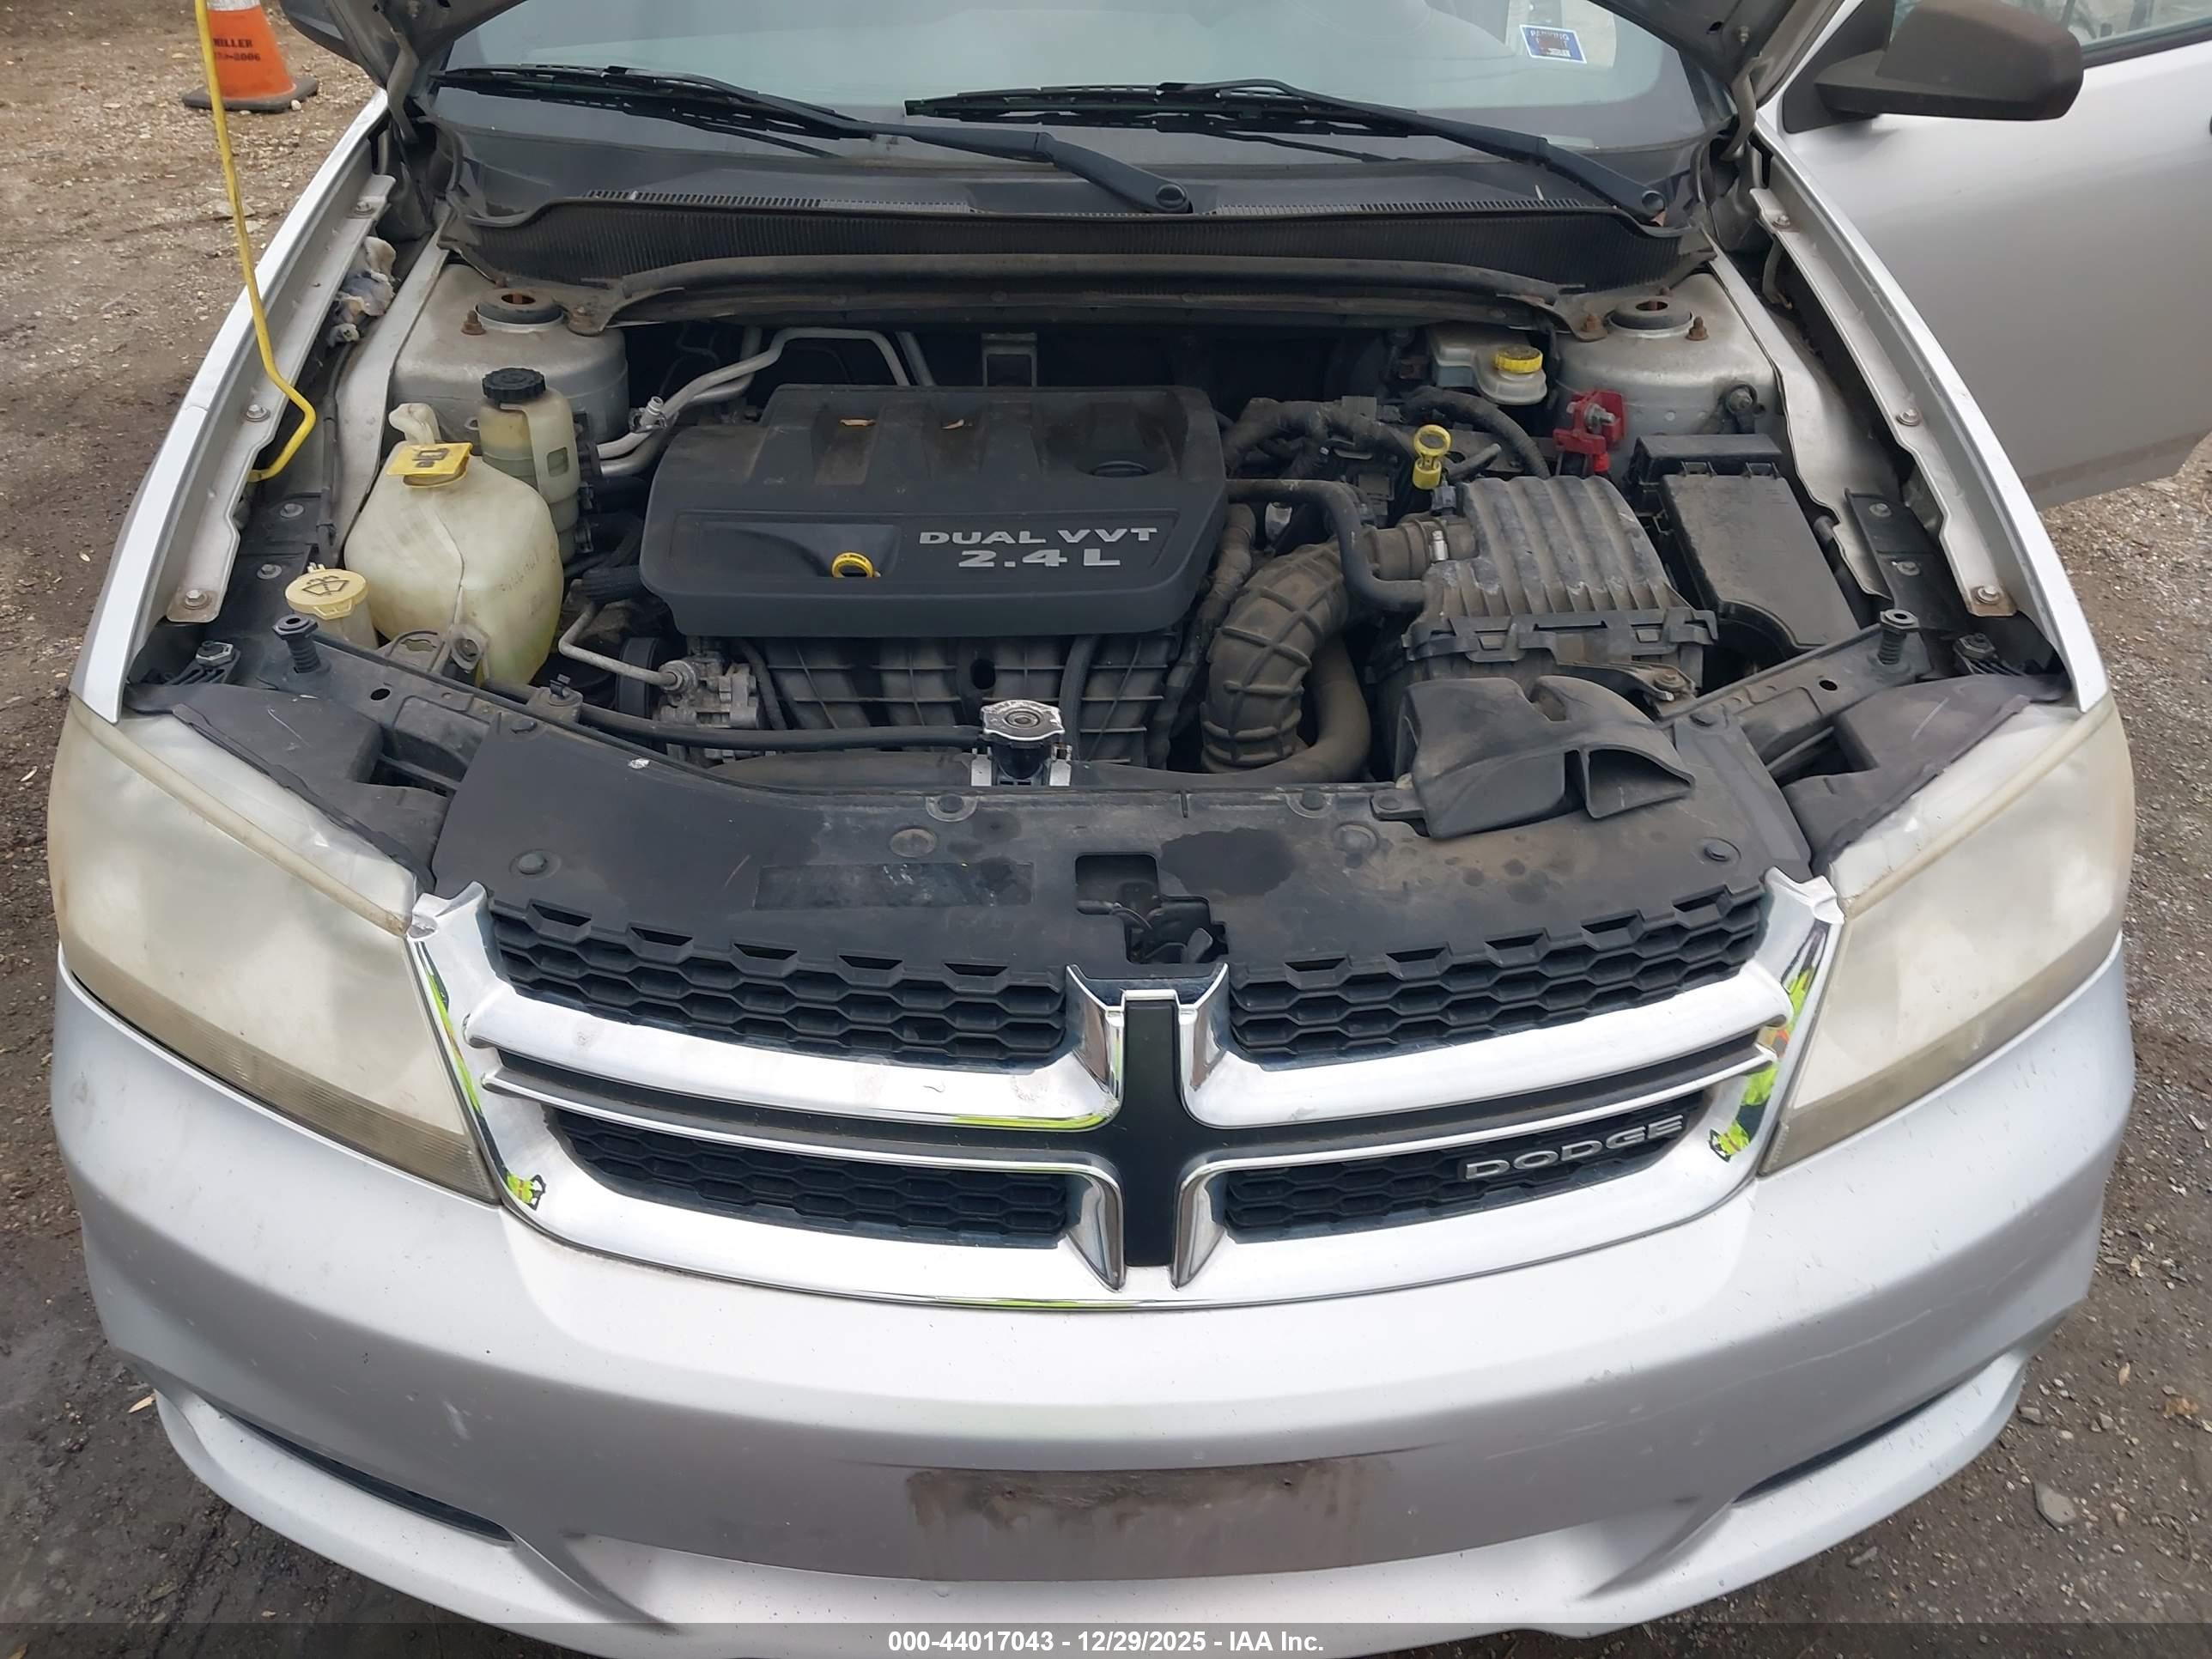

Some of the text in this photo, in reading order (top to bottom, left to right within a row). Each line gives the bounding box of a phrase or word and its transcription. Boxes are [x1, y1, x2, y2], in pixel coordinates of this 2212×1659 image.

[919, 527, 1158, 544] DUAL VVT
[1465, 1114, 1684, 1180] DODGE
